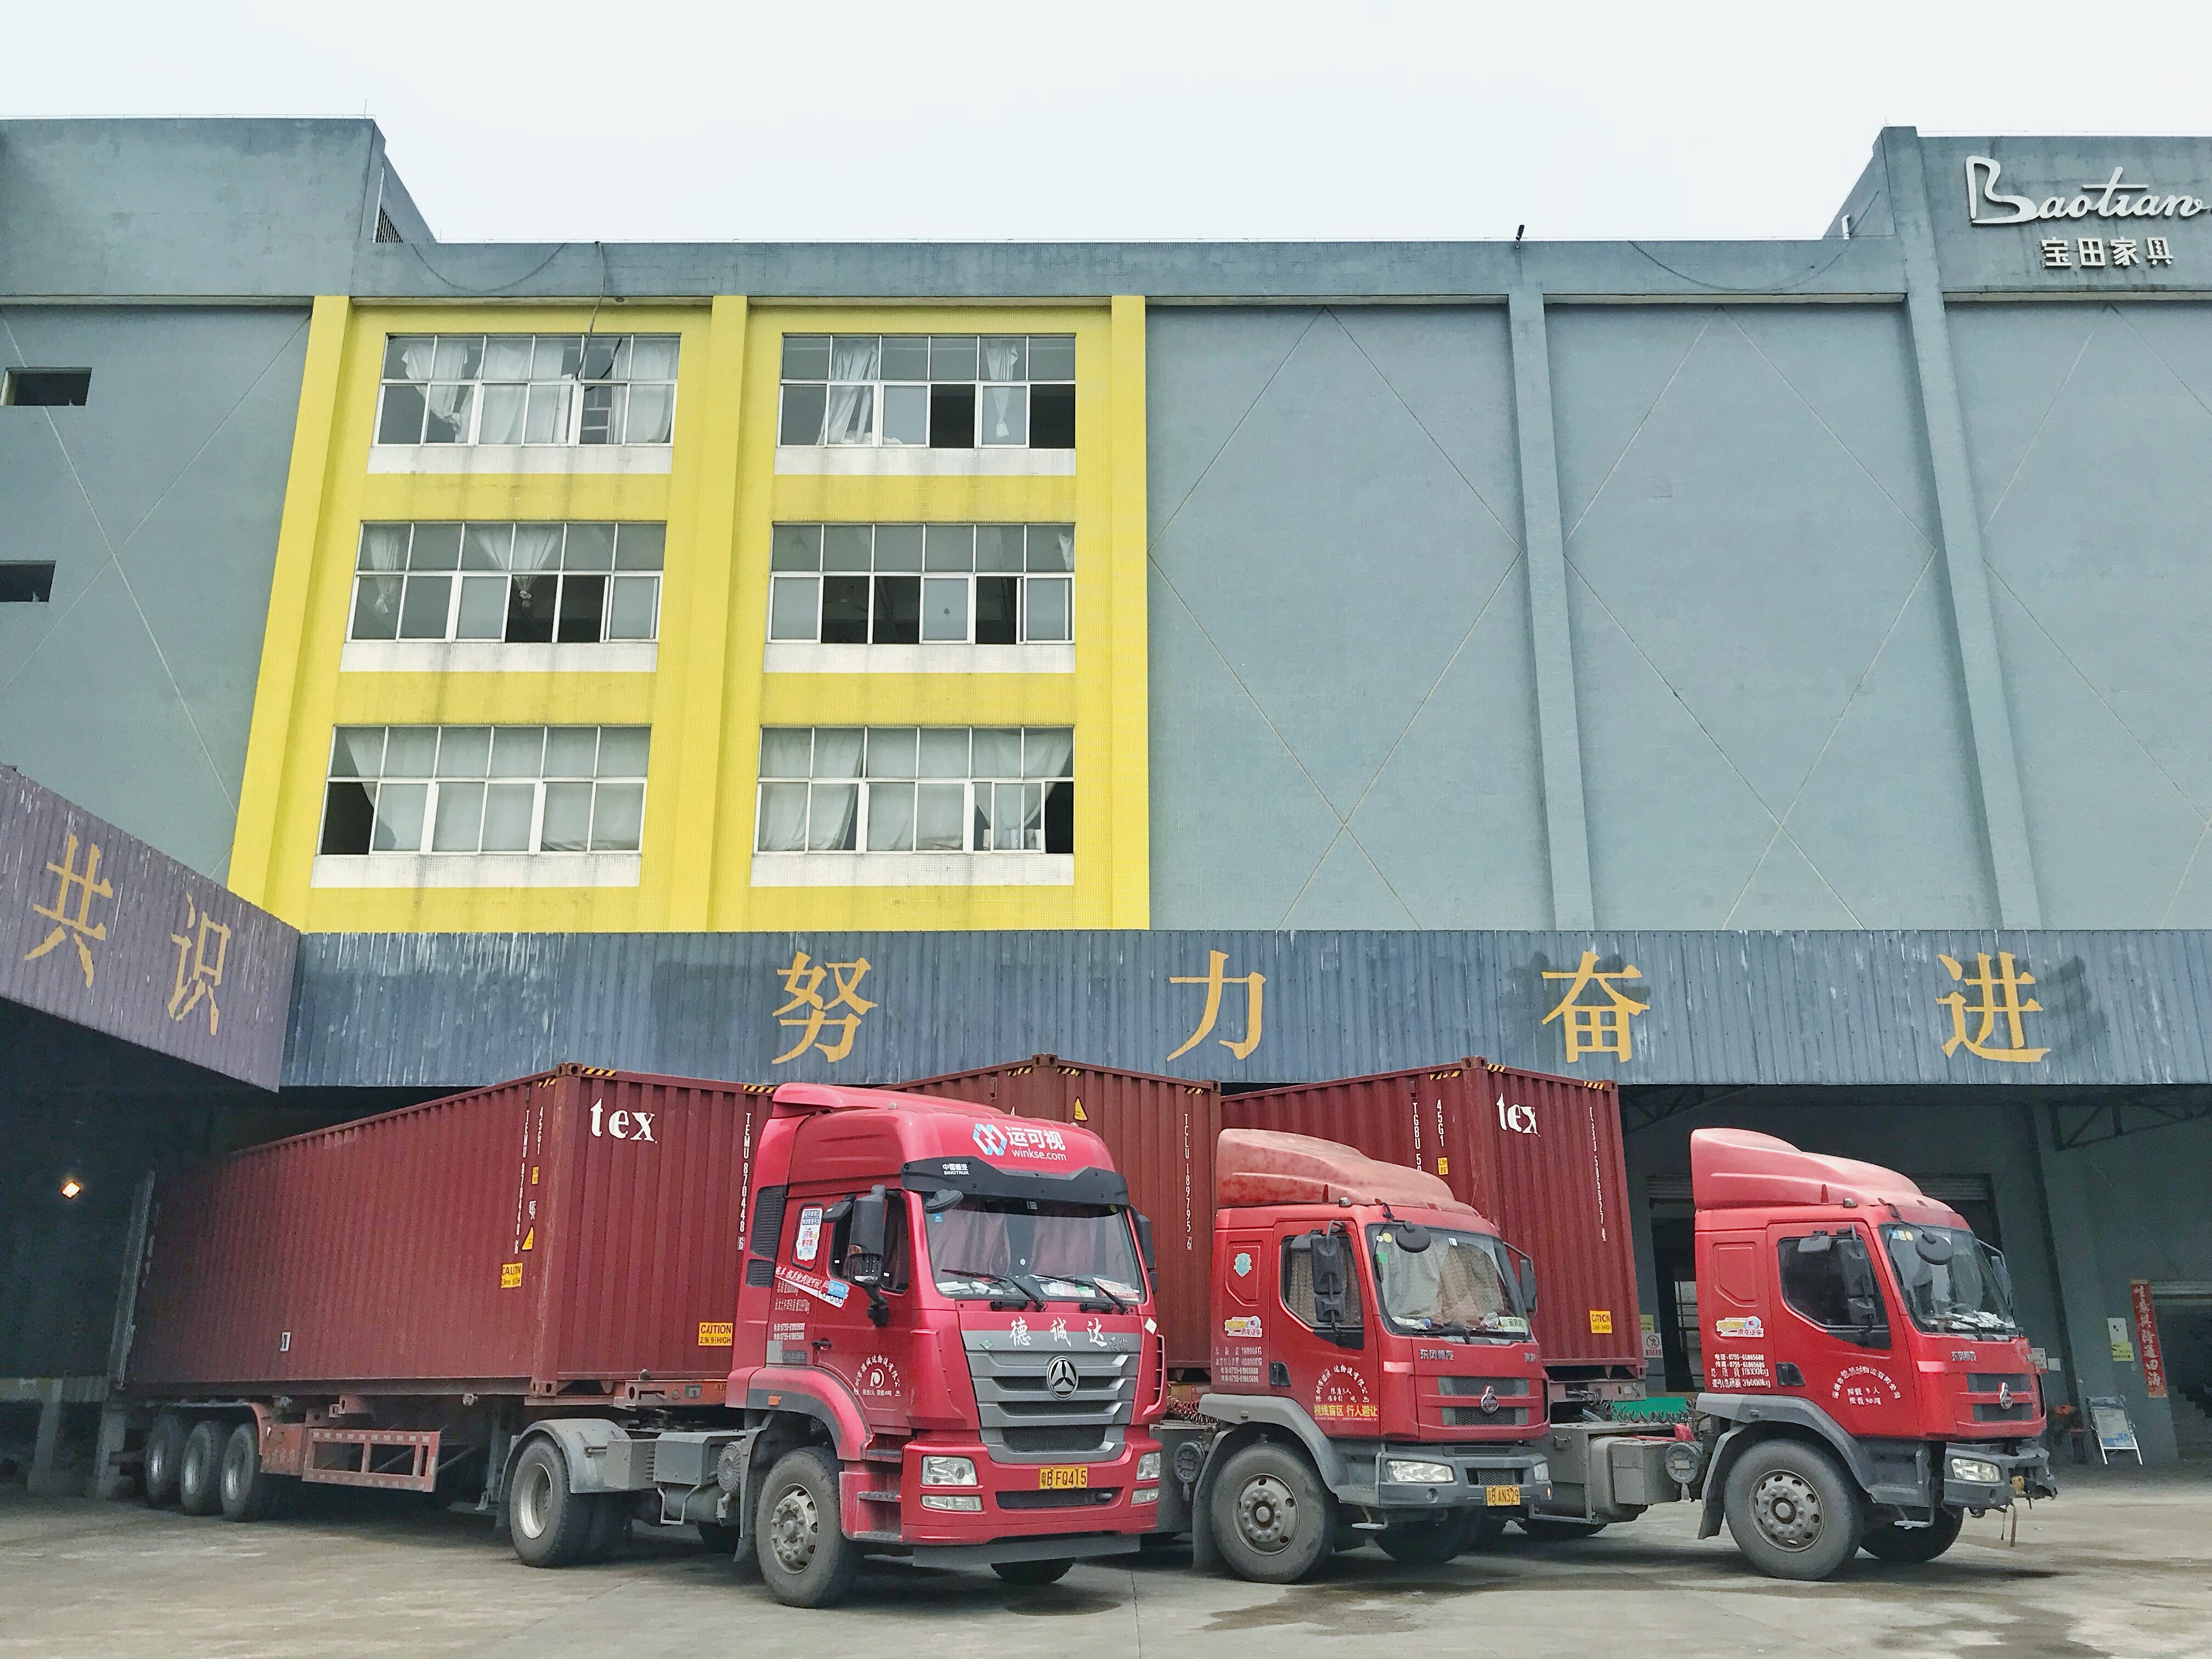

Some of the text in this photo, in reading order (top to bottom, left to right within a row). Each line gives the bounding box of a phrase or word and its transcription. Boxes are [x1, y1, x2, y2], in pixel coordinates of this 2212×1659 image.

[1966, 155, 2211, 224] Baotian
[2041, 236, 2174, 267] 宝田家具
[24, 834, 232, 1036] 共识
[590, 1098, 655, 1142] tex
[1497, 1093, 1538, 1135] tex
[1005, 1126, 1066, 1150] 运可视
[1012, 1148, 1066, 1161] winkse.com
[740, 1163, 748, 1232] 870448
[738, 1237, 745, 1250] 6
[1187, 1237, 1192, 1250] 6
[1010, 1316, 1108, 1347] 德诚达
[1346, 1405, 1378, 1417] 行人避让
